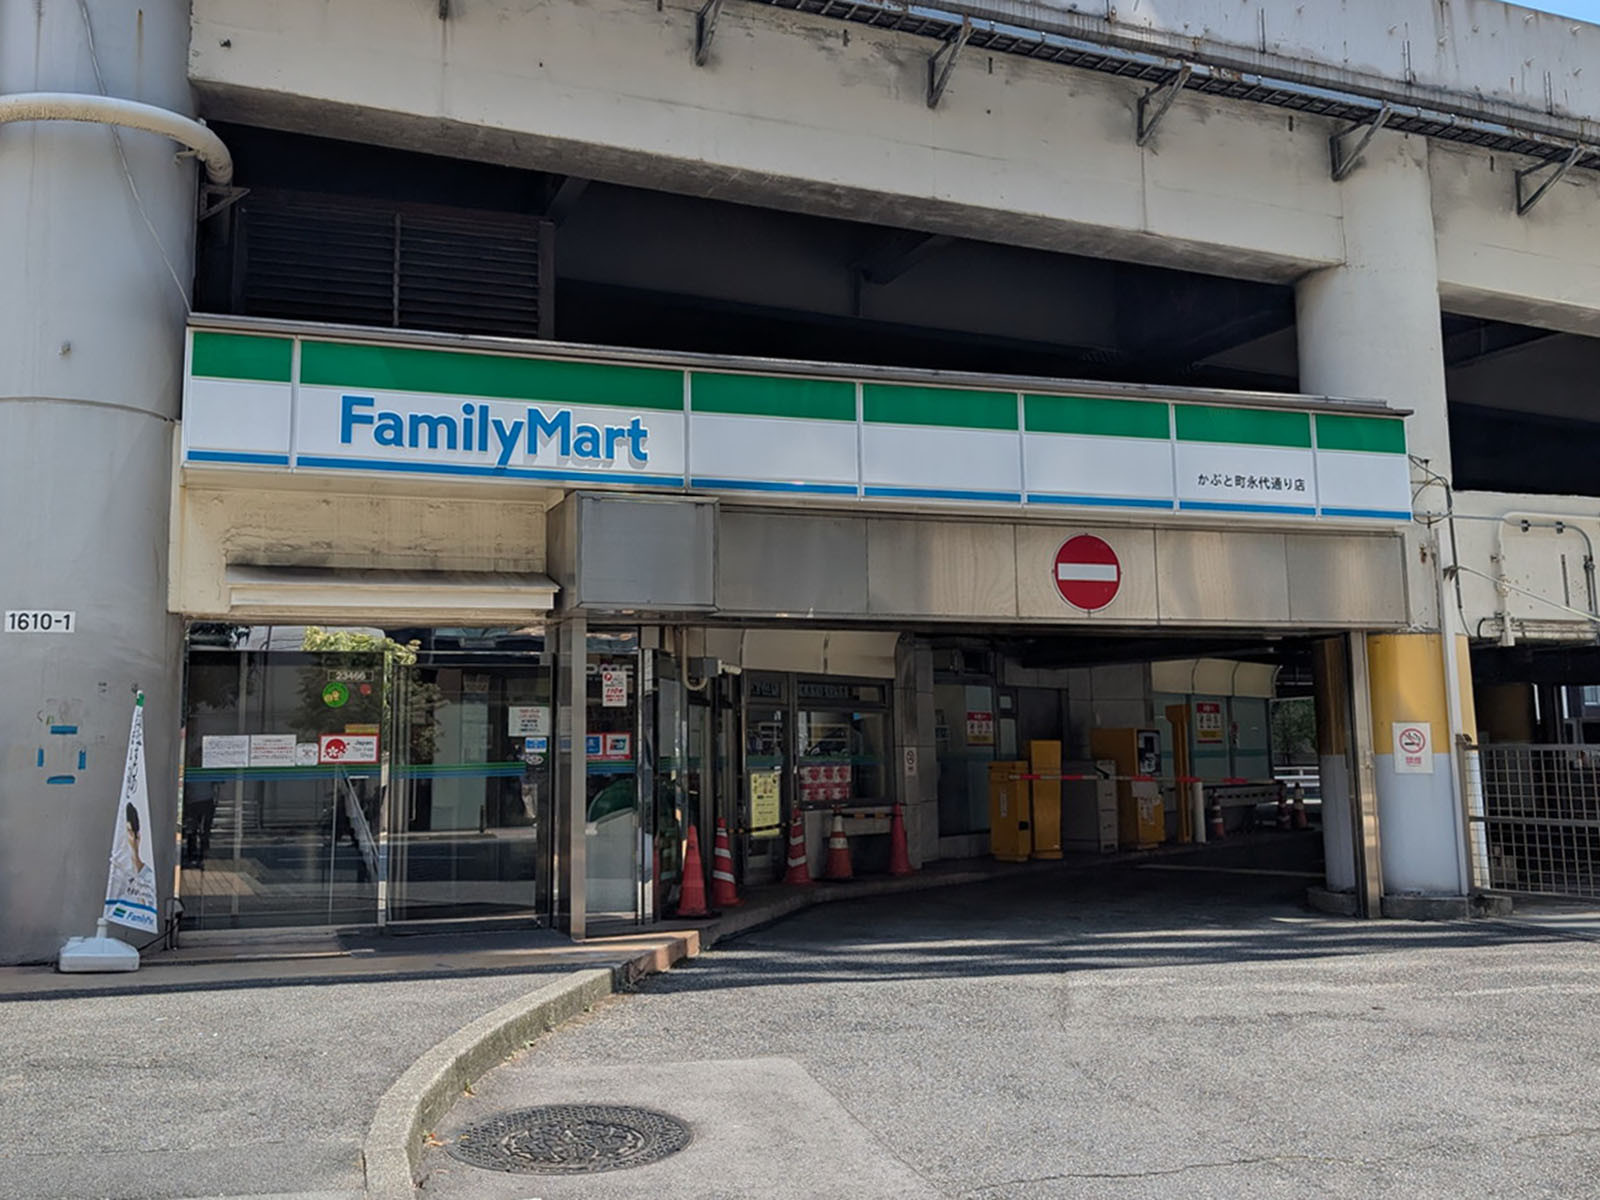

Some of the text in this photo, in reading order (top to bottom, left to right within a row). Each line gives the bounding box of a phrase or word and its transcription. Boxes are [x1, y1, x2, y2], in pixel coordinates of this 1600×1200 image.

[340, 395, 648, 467] FamilyMart
[1198, 473, 1305, 491] かぶと町永代通り店
[9, 612, 70, 630] 1610-1
